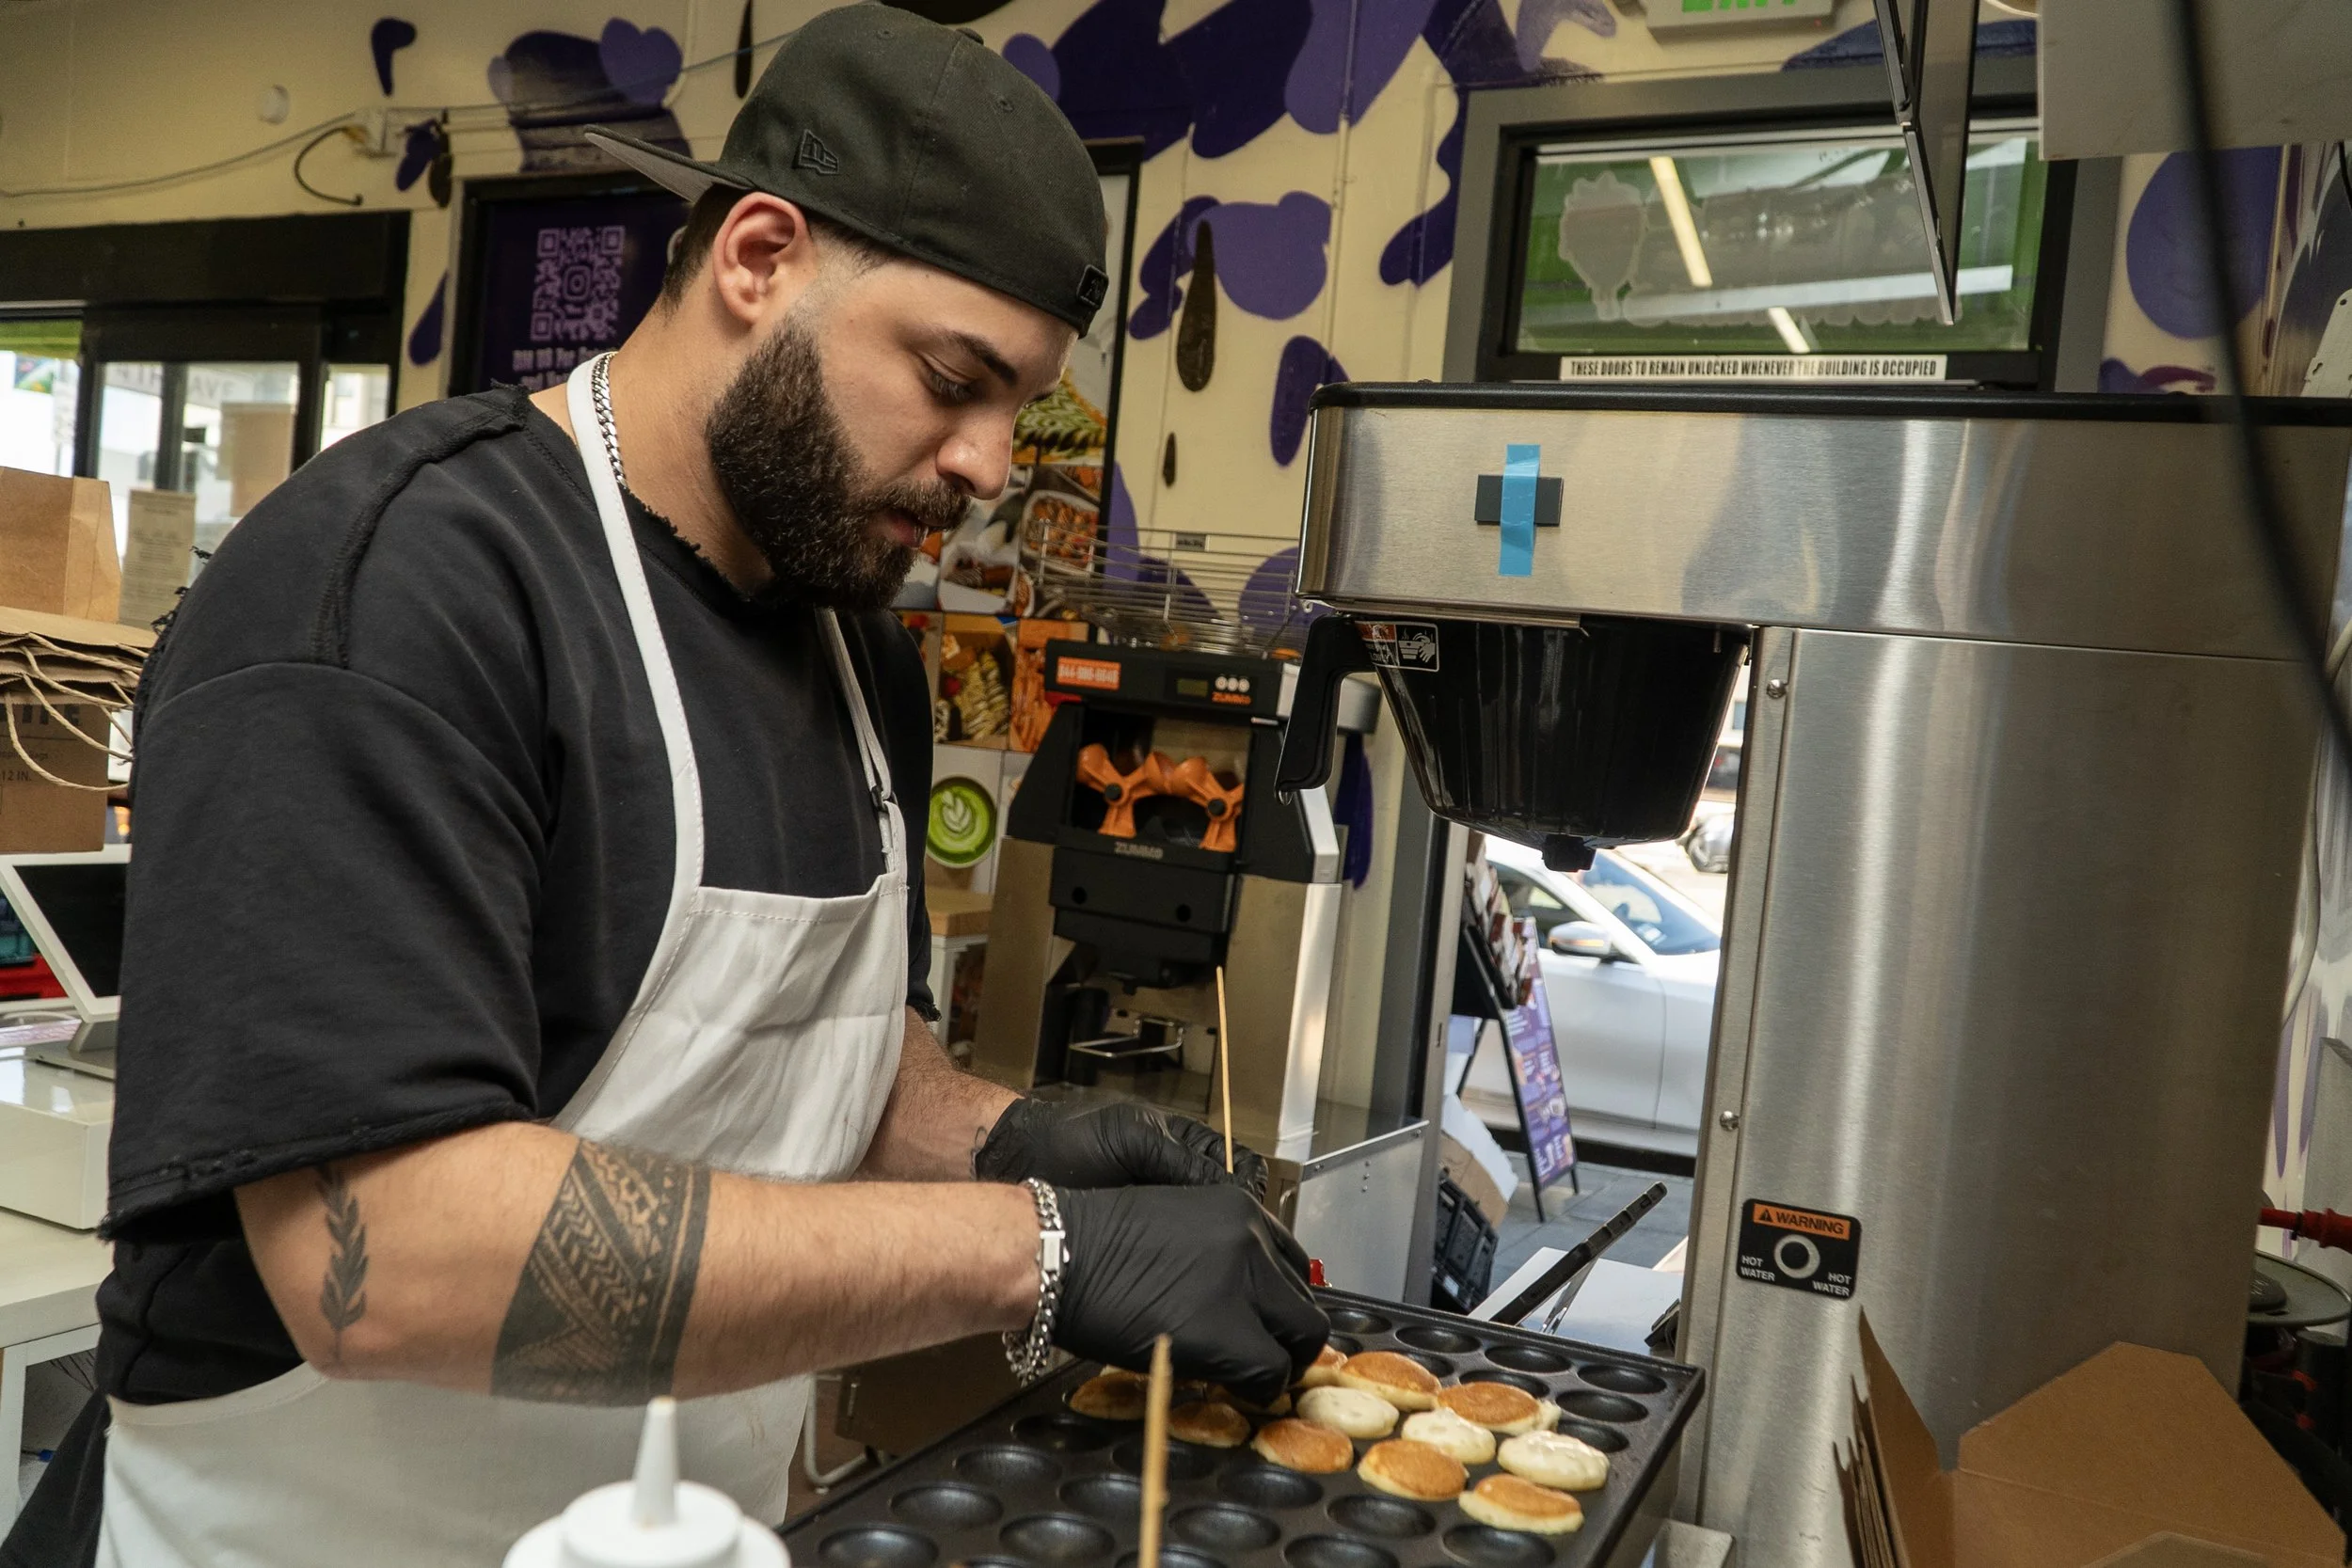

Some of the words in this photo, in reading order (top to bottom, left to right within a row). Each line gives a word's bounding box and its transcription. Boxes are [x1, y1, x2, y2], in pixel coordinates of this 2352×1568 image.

[1570, 360, 1599, 376] THESE
[1600, 360, 1633, 376] DOORS
[1635, 360, 1647, 376] TO
[1648, 360, 1686, 376] REMAIN
[1688, 360, 1739, 376] UNLOCKED
[1740, 359, 1795, 376] WHENEVER
[1796, 359, 1818, 376] THE
[1818, 359, 1867, 376] BUILDING
[1868, 359, 1881, 376] IS
[1882, 359, 1938, 376] OCCUPIED
[1776, 1212, 1844, 1234] WARNING
[1741, 1255, 1763, 1267] HOT
[1740, 1267, 1775, 1281] WATER
[1828, 1273, 1851, 1285] HOT
[1813, 1281, 1850, 1296] WATER
